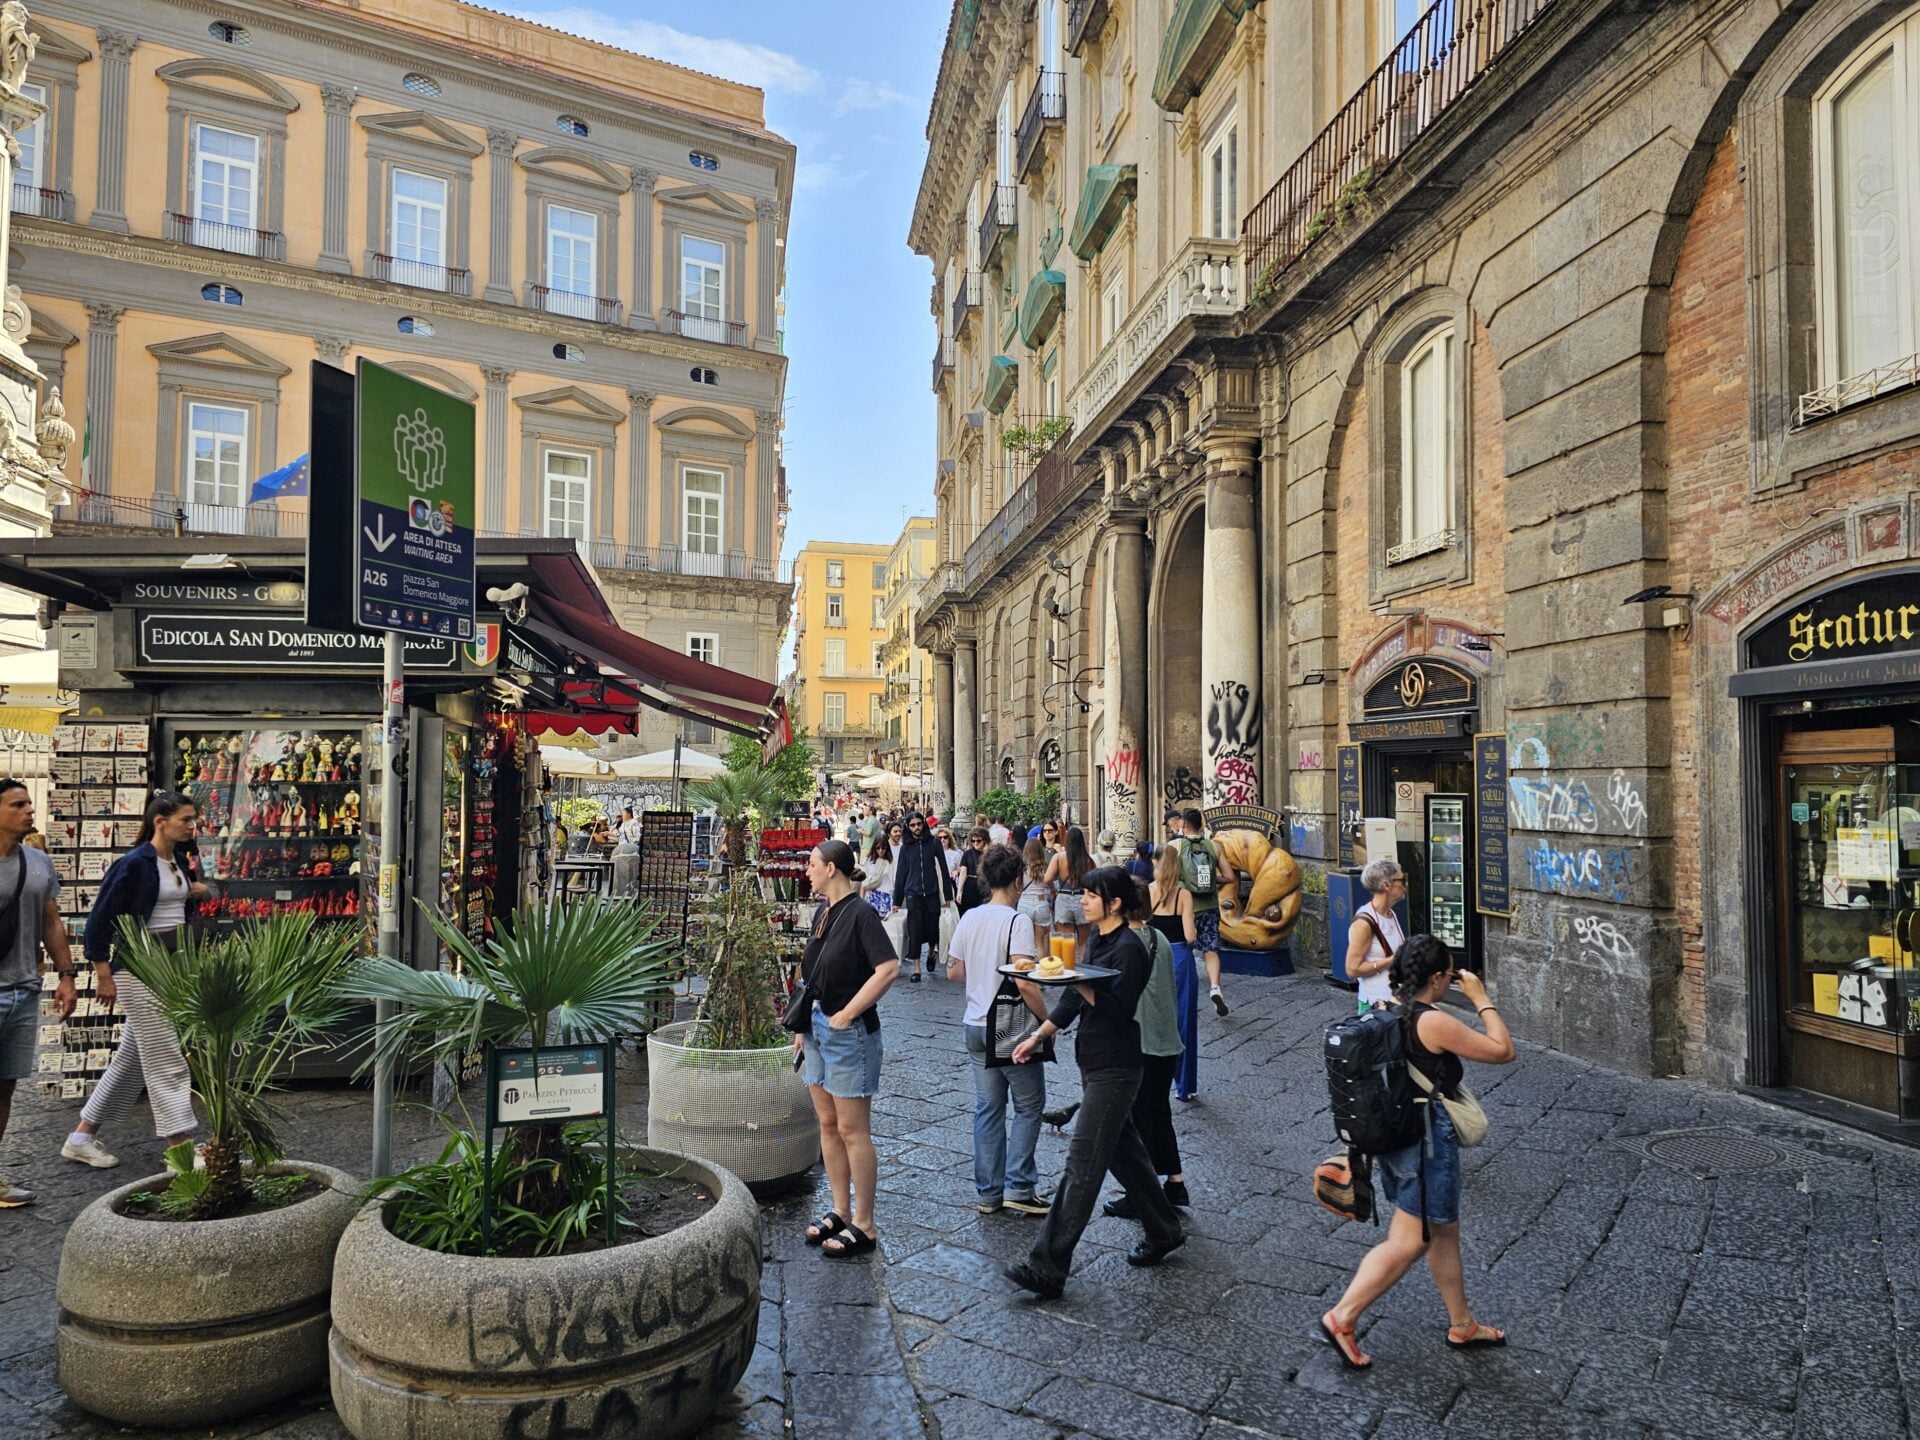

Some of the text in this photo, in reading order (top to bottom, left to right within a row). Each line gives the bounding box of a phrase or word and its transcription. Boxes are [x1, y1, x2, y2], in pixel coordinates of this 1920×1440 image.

[403, 531, 462, 554] AREA DI ATTESA
[404, 545, 454, 565] WAITING AREA
[363, 569, 388, 587] A26
[403, 573, 440, 589] piazza San
[135, 583, 238, 601] SOUVENIRS
[403, 585, 438, 600] Domenico
[438, 592, 470, 607] Maggiore
[151, 628, 446, 650] EDICOLA SAN DOMENICO MAIORE
[1788, 601, 1920, 661] Scatur
[1240, 806, 1277, 824] NAPOLETANA
[559, 1086, 597, 1097] PETRUCCI
